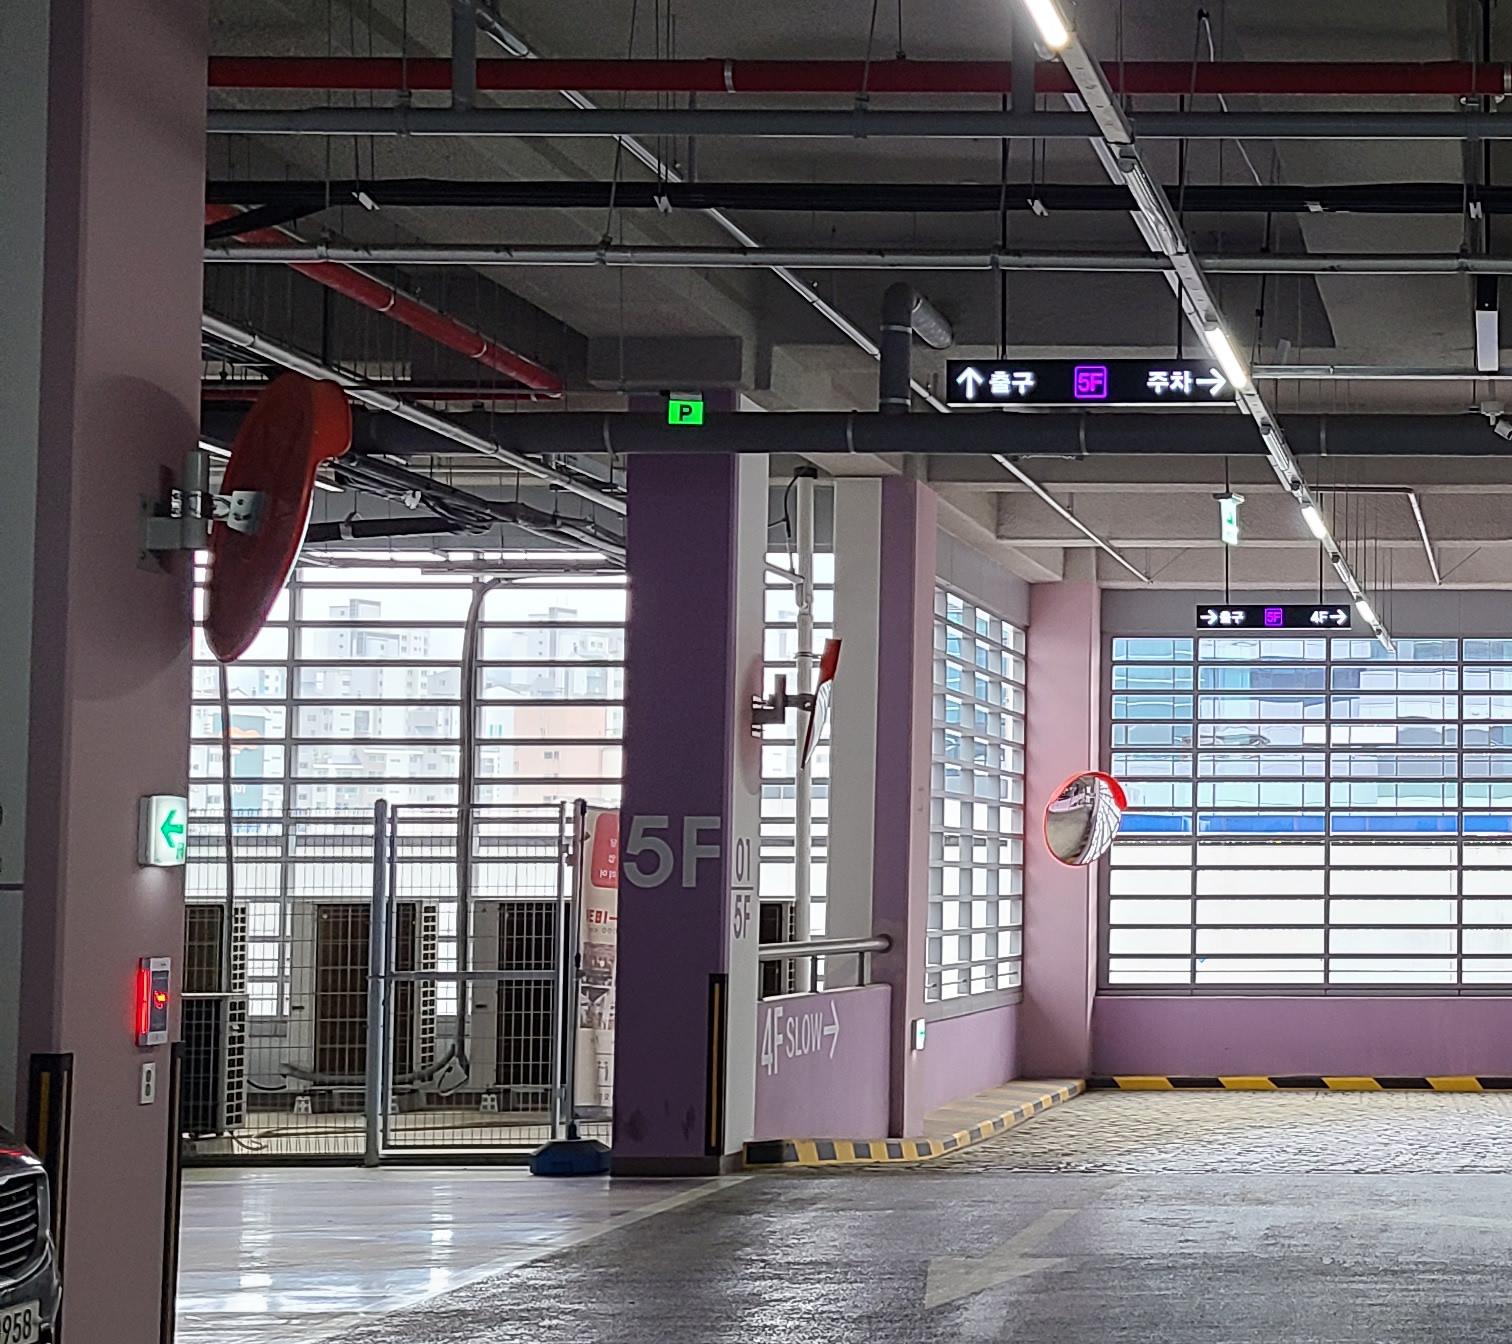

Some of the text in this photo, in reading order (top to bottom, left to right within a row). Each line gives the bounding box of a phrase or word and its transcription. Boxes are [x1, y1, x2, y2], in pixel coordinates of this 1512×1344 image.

[988, 369, 1192, 396] 출구 5F 주차
[679, 404, 693, 422] P
[1266, 611, 1282, 623] 5F
[1310, 610, 1329, 624] 4F
[623, 815, 722, 888] 5F
[736, 838, 750, 882] 01
[733, 895, 751, 939] 5F
[761, 1005, 824, 1076] 4F SLOW
